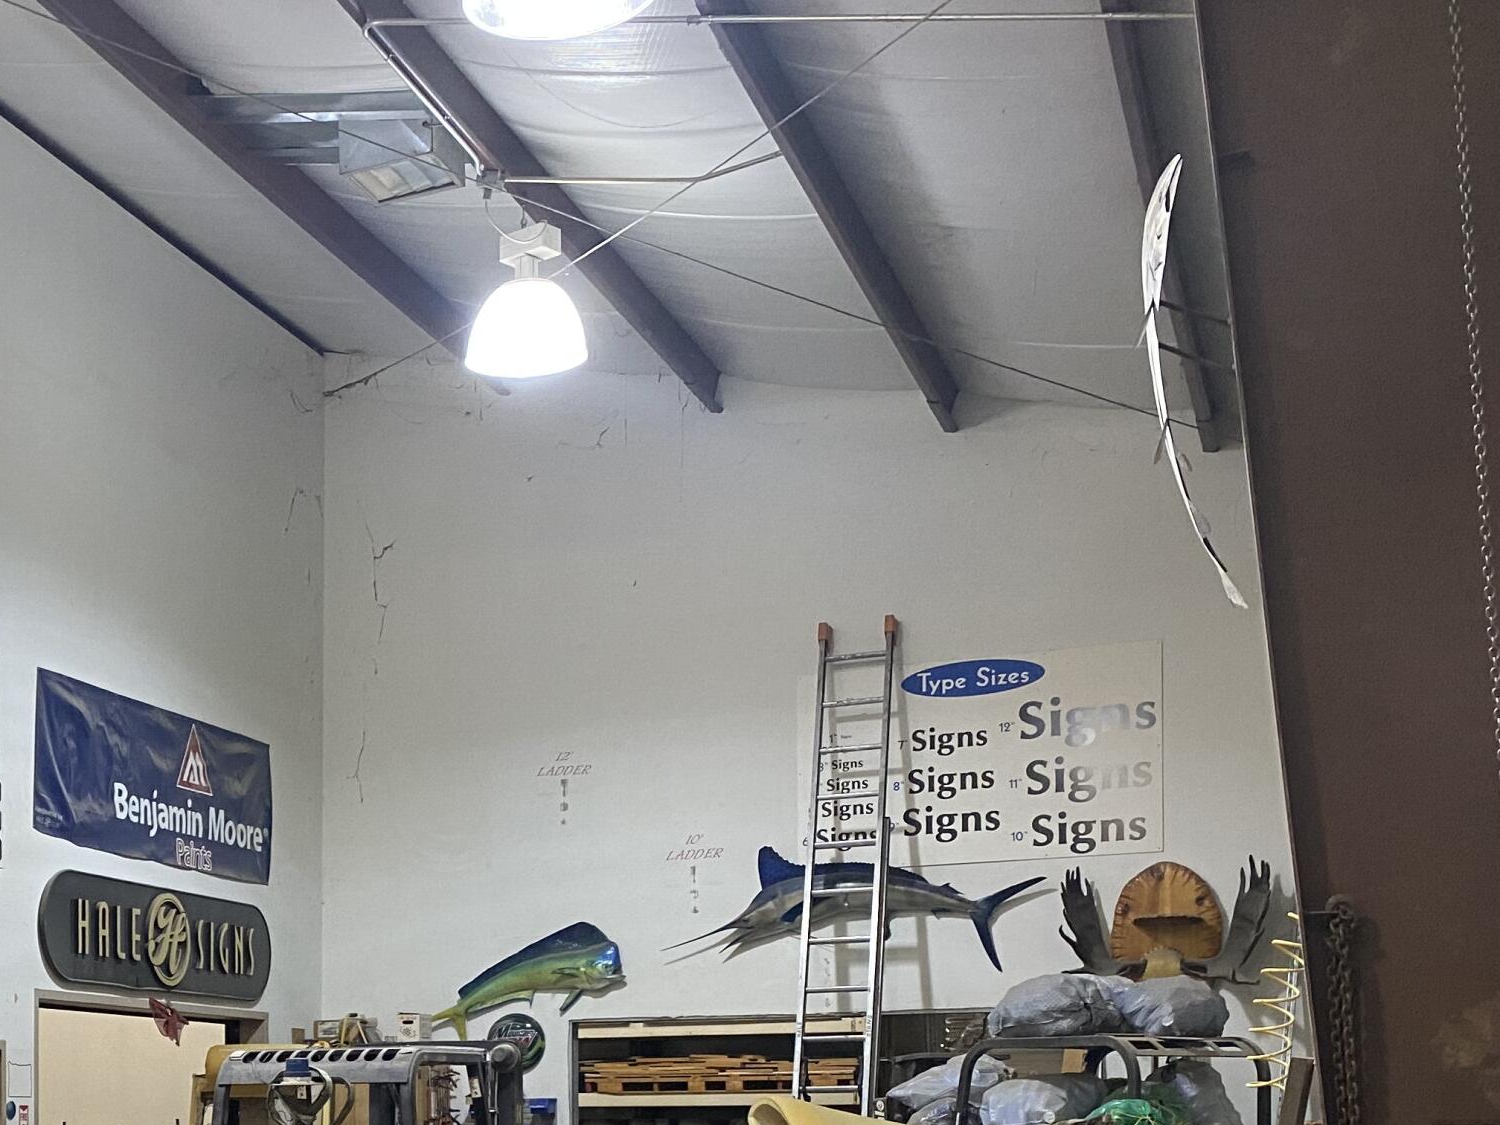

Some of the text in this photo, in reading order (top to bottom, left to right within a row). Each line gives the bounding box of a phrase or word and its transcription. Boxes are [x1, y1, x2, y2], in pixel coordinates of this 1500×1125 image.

[917, 667, 1029, 695] Type Sizes
[1019, 697, 1157, 747] Signs
[912, 727, 988, 756] Signs
[537, 765, 592, 777] LADDER
[831, 760, 863, 771] Signs
[1026, 756, 1153, 802] Signs
[826, 778, 869, 794] Signs
[908, 766, 995, 799] Signs
[113, 782, 202, 838] Benjamin
[821, 801, 874, 820] Signs
[903, 806, 1000, 842] Signs
[1031, 811, 1147, 854] Signs
[176, 838, 212, 871] Paints
[666, 847, 724, 861] LADDER
[75, 898, 142, 961] HALE
[195, 919, 255, 976] SIGNS
